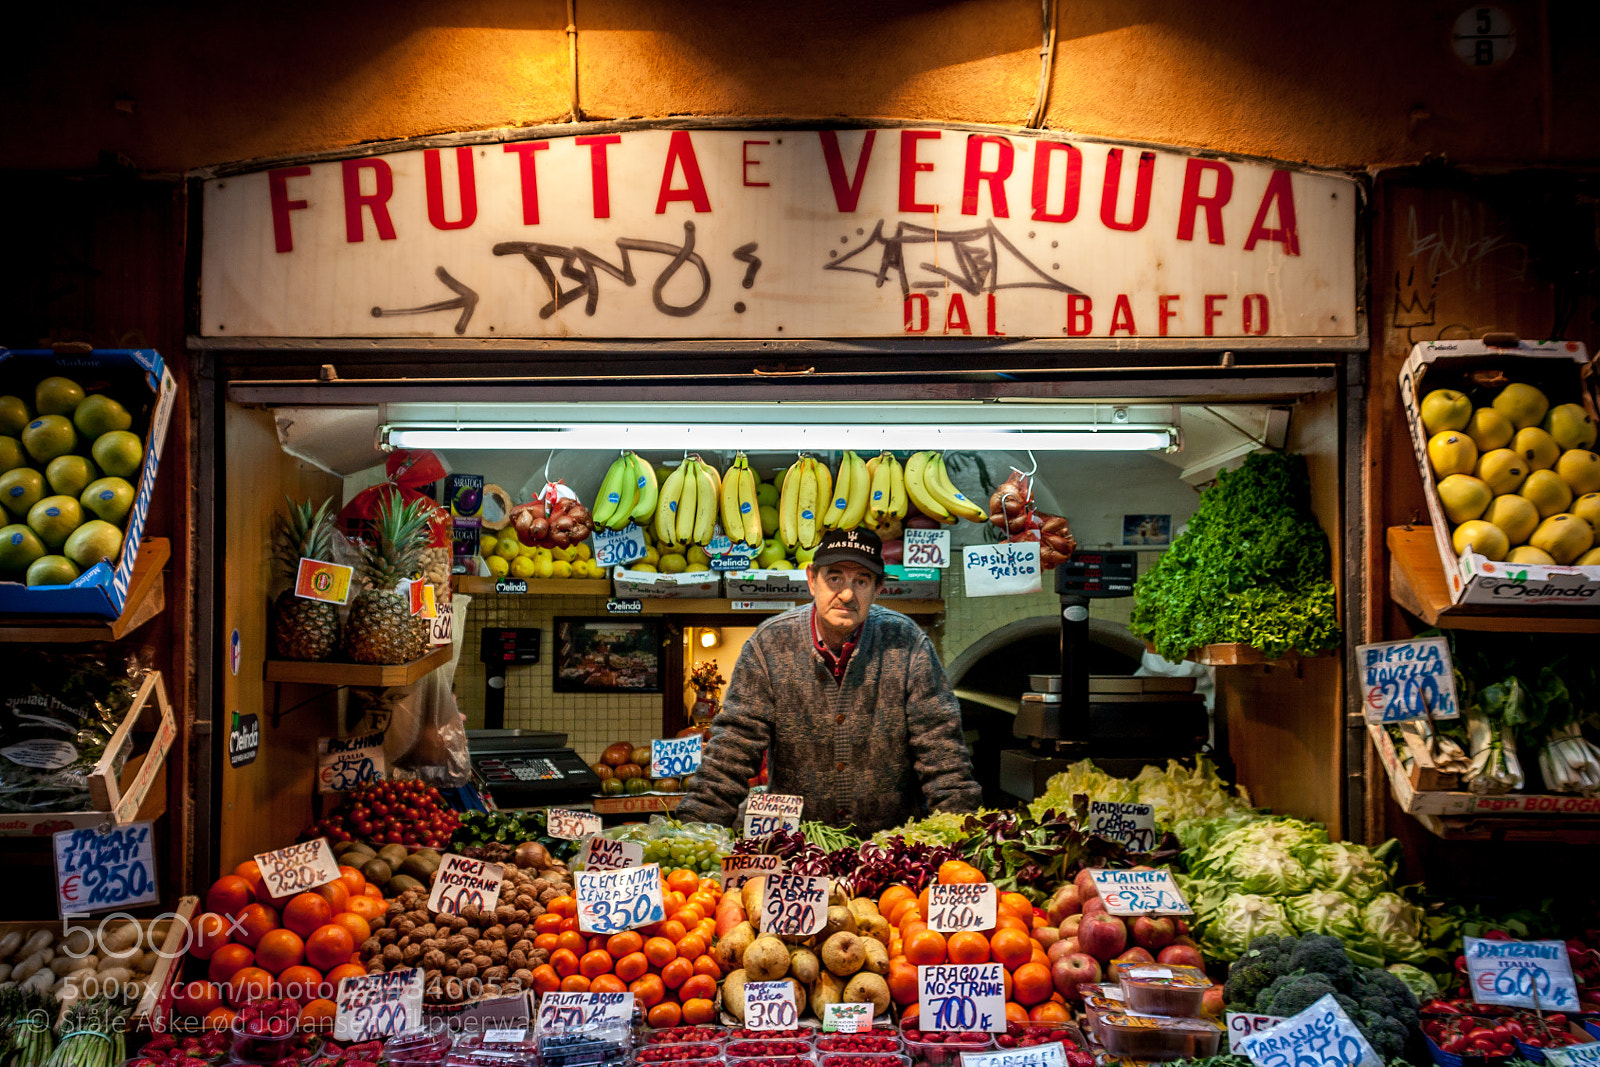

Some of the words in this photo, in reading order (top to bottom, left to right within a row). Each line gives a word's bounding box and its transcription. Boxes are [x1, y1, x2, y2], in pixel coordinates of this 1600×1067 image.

[1476, 8, 1492, 34] 5
[267, 131, 712, 254] FRUTTA
[743, 140, 771, 187] E
[818, 130, 1301, 257] VERDURA
[903, 292, 1007, 336] DAL
[1066, 292, 1271, 337] BAFFO
[453, 477, 483, 489] SARATOGA
[112, 447, 159, 610] Marlene
[827, 540, 876, 555] MASERATI
[711, 556, 750, 567] Melinda
[496, 582, 527, 592] Melinda
[739, 583, 799, 594] Melinda
[1493, 583, 1597, 598] Melinda
[606, 600, 642, 611] Melinda
[1366, 643, 1441, 667] BIETOLA
[1366, 659, 1444, 687] NOVELLA
[229, 721, 260, 754] Melinda
[327, 731, 385, 754] PACHINO
[748, 800, 799, 815] ROMAGNA
[1091, 801, 1150, 816] RADICCHIO
[1096, 816, 1136, 831] CAMPO
[256, 839, 322, 867] TAROCCO
[590, 838, 624, 856] UVA
[273, 852, 320, 874] DOLCE
[449, 856, 485, 877] NOCI
[587, 851, 633, 869] DOLCE
[721, 856, 779, 872] TREVISO
[440, 872, 499, 893] NOSTRANE
[579, 866, 660, 890] CLEMENTINI
[767, 874, 817, 891] PERE
[578, 888, 621, 902] SENZA
[768, 887, 825, 903] ABATE
[931, 884, 989, 896] TAROCCO
[930, 893, 981, 907] SUGOSO
[1497, 960, 1539, 969] ITALIA
[924, 965, 1000, 983] FRAGOLE
[924, 981, 1004, 997] NOSTRANE
[1247, 1011, 1335, 1059] TARASSACO
